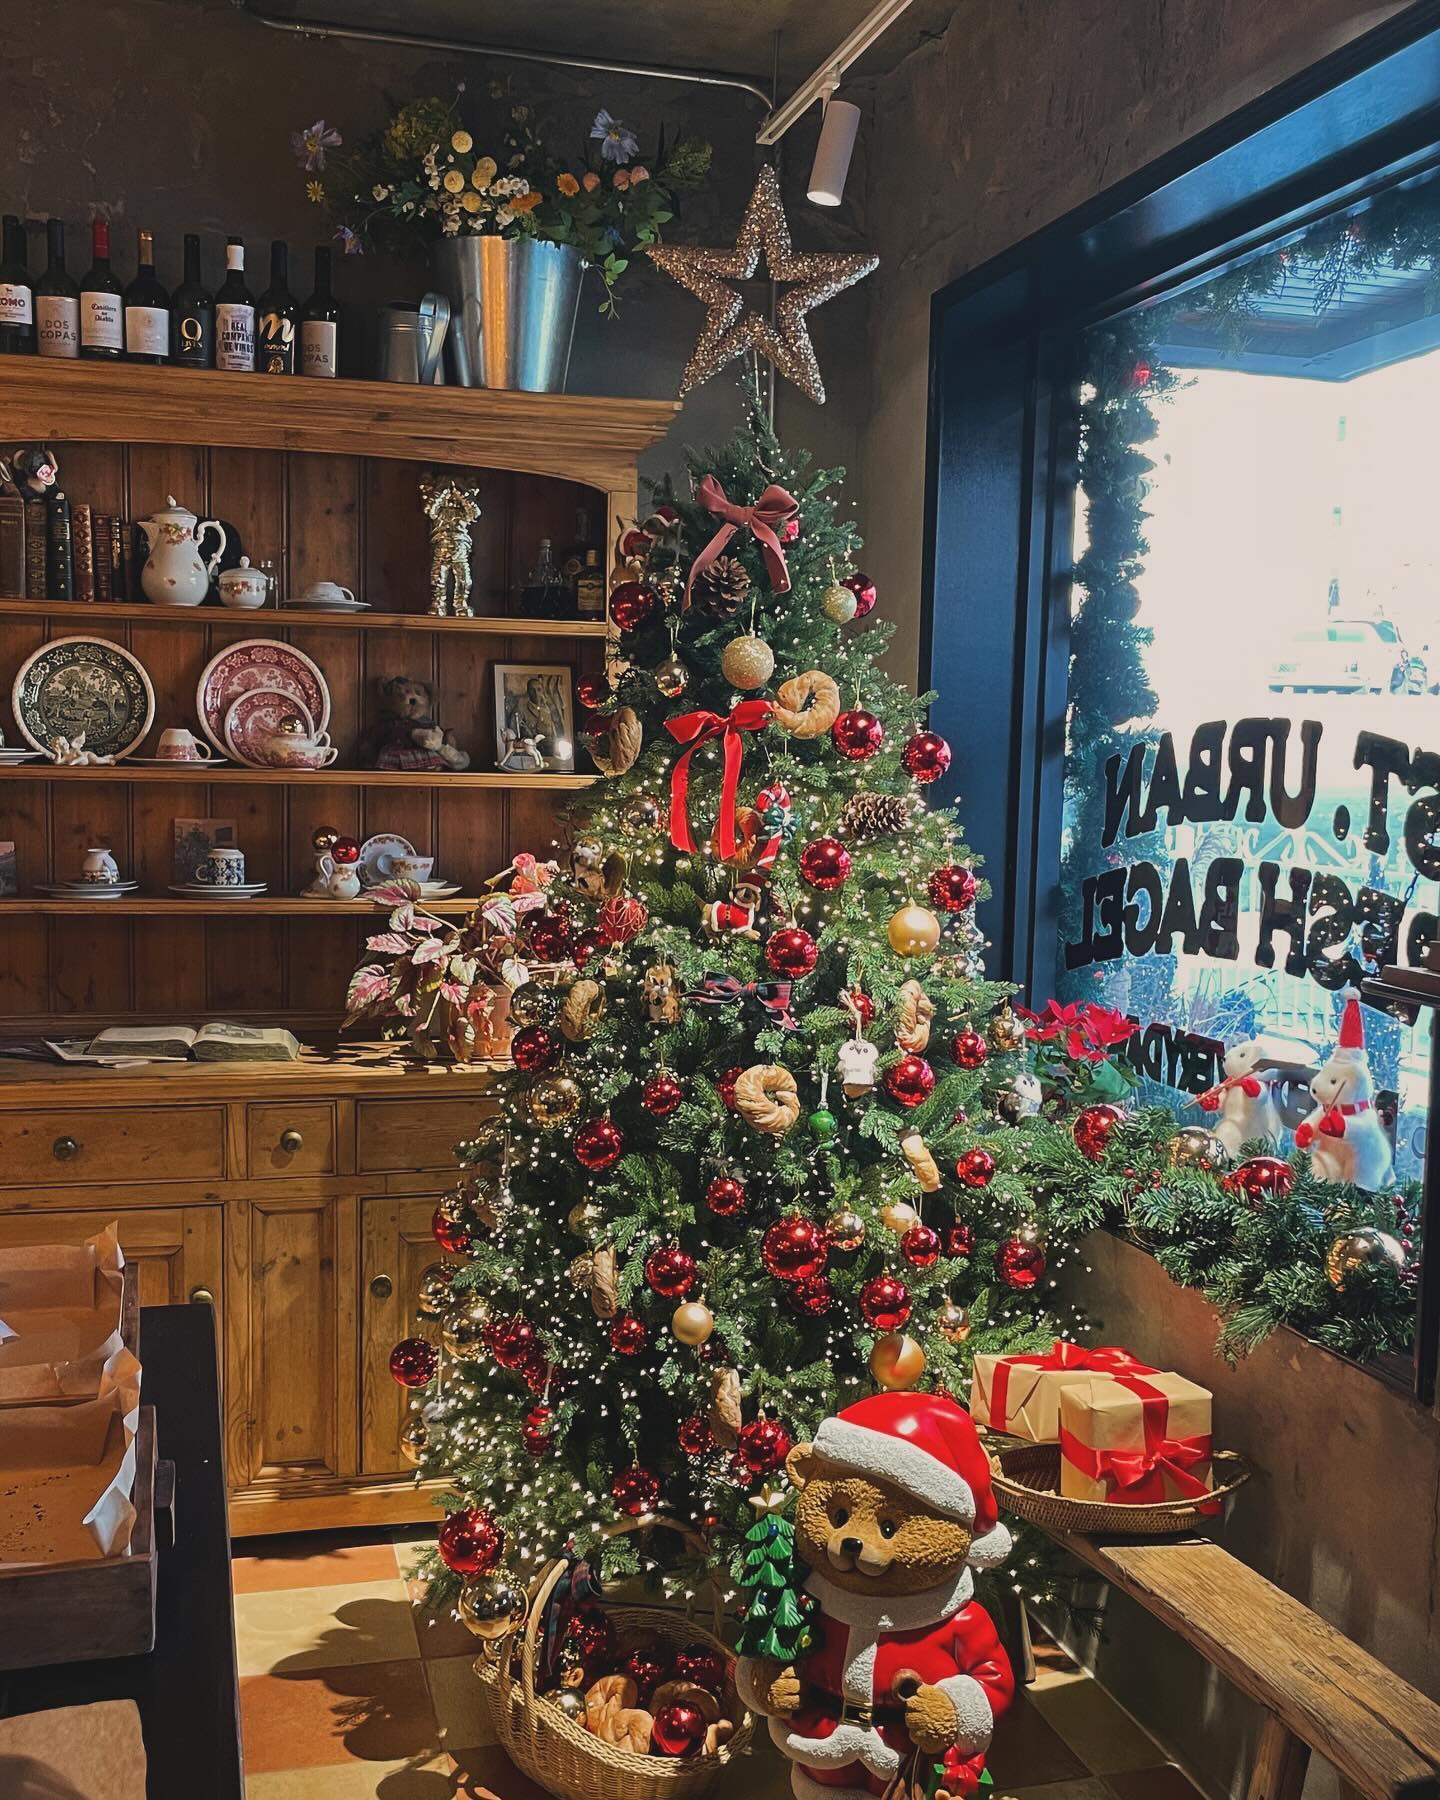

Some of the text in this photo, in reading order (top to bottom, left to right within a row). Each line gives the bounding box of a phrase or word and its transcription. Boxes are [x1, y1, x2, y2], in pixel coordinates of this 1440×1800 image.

[0, 298, 25, 307] OMO
[45, 320, 70, 330] DOS
[40, 330, 77, 341] COPAS
[303, 354, 329, 363] OPAS
